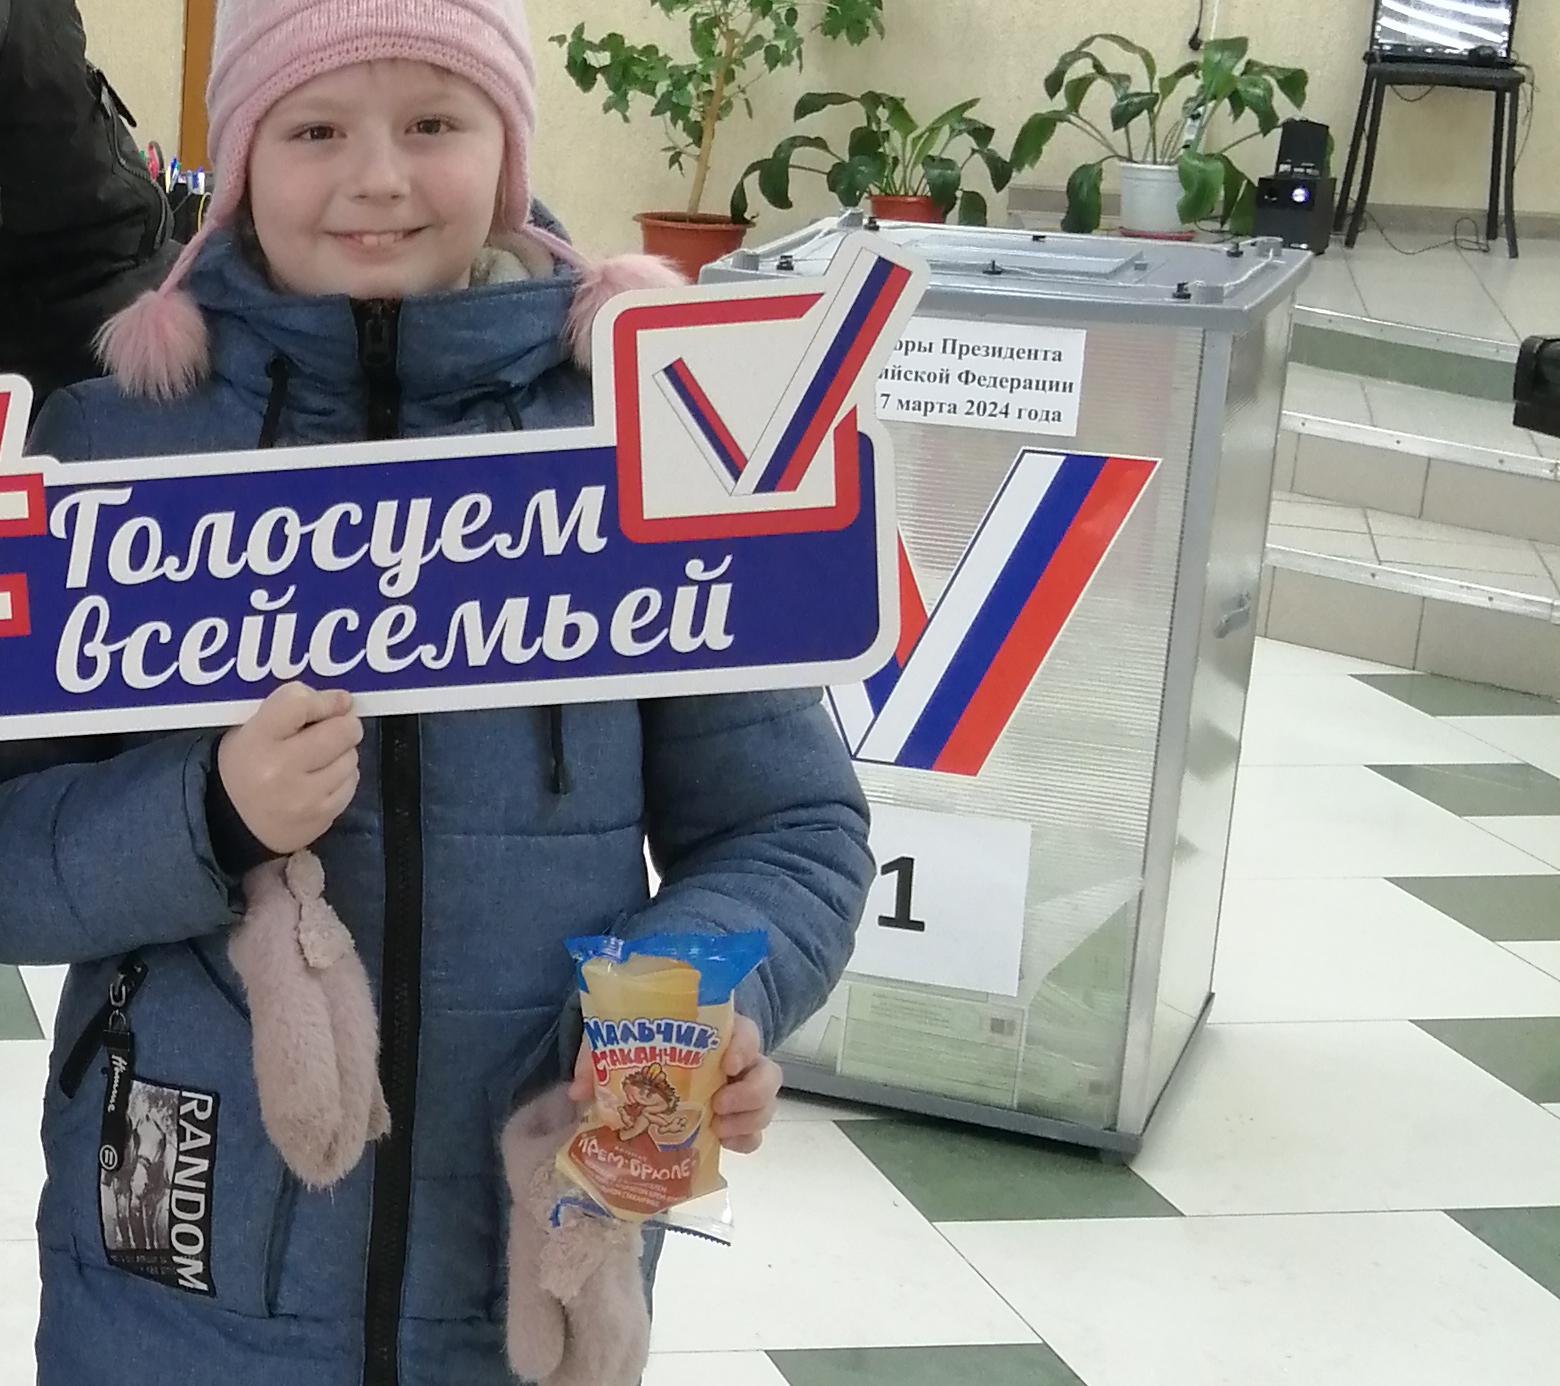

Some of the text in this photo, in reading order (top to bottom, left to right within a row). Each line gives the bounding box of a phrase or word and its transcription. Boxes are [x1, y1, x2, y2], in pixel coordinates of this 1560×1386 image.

[940, 337, 1063, 363] Президента
[956, 369, 1074, 394] Федерации
[896, 398, 958, 418] марта
[963, 399, 1011, 419] 2024
[1016, 407, 1063, 424] года
[48, 483, 610, 598] Голосуем
[877, 855, 926, 933] 1
[170, 1090, 213, 1292] RANDOM
